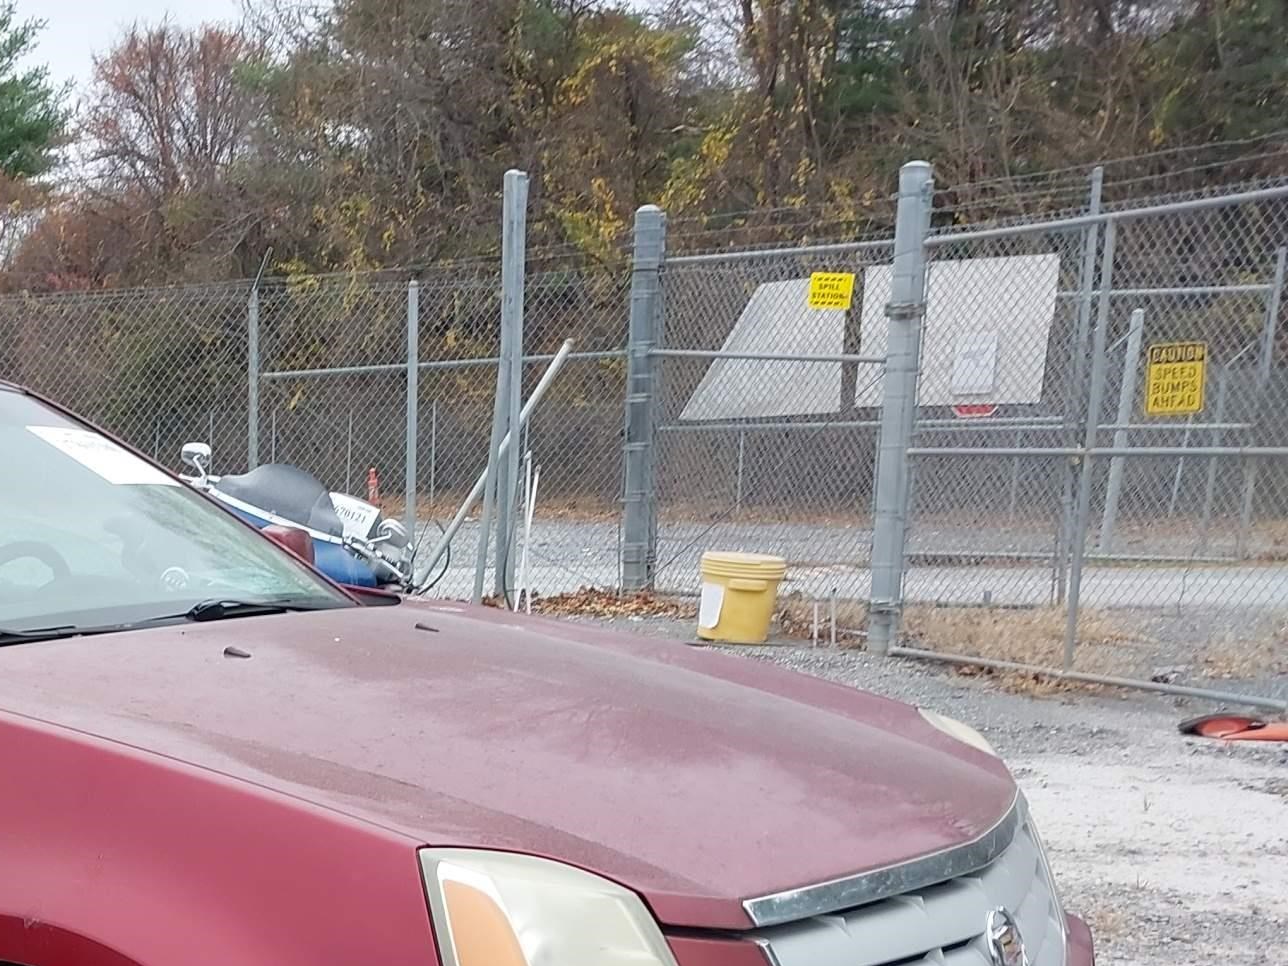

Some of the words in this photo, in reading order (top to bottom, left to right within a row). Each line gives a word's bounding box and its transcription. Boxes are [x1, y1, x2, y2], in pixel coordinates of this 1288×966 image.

[812, 292, 844, 300] STATION
[1152, 346, 1203, 363] CAUTION
[1154, 366, 1197, 380] SPEED
[1152, 380, 1197, 395] BUMPS
[1152, 394, 1196, 408] AHEAD
